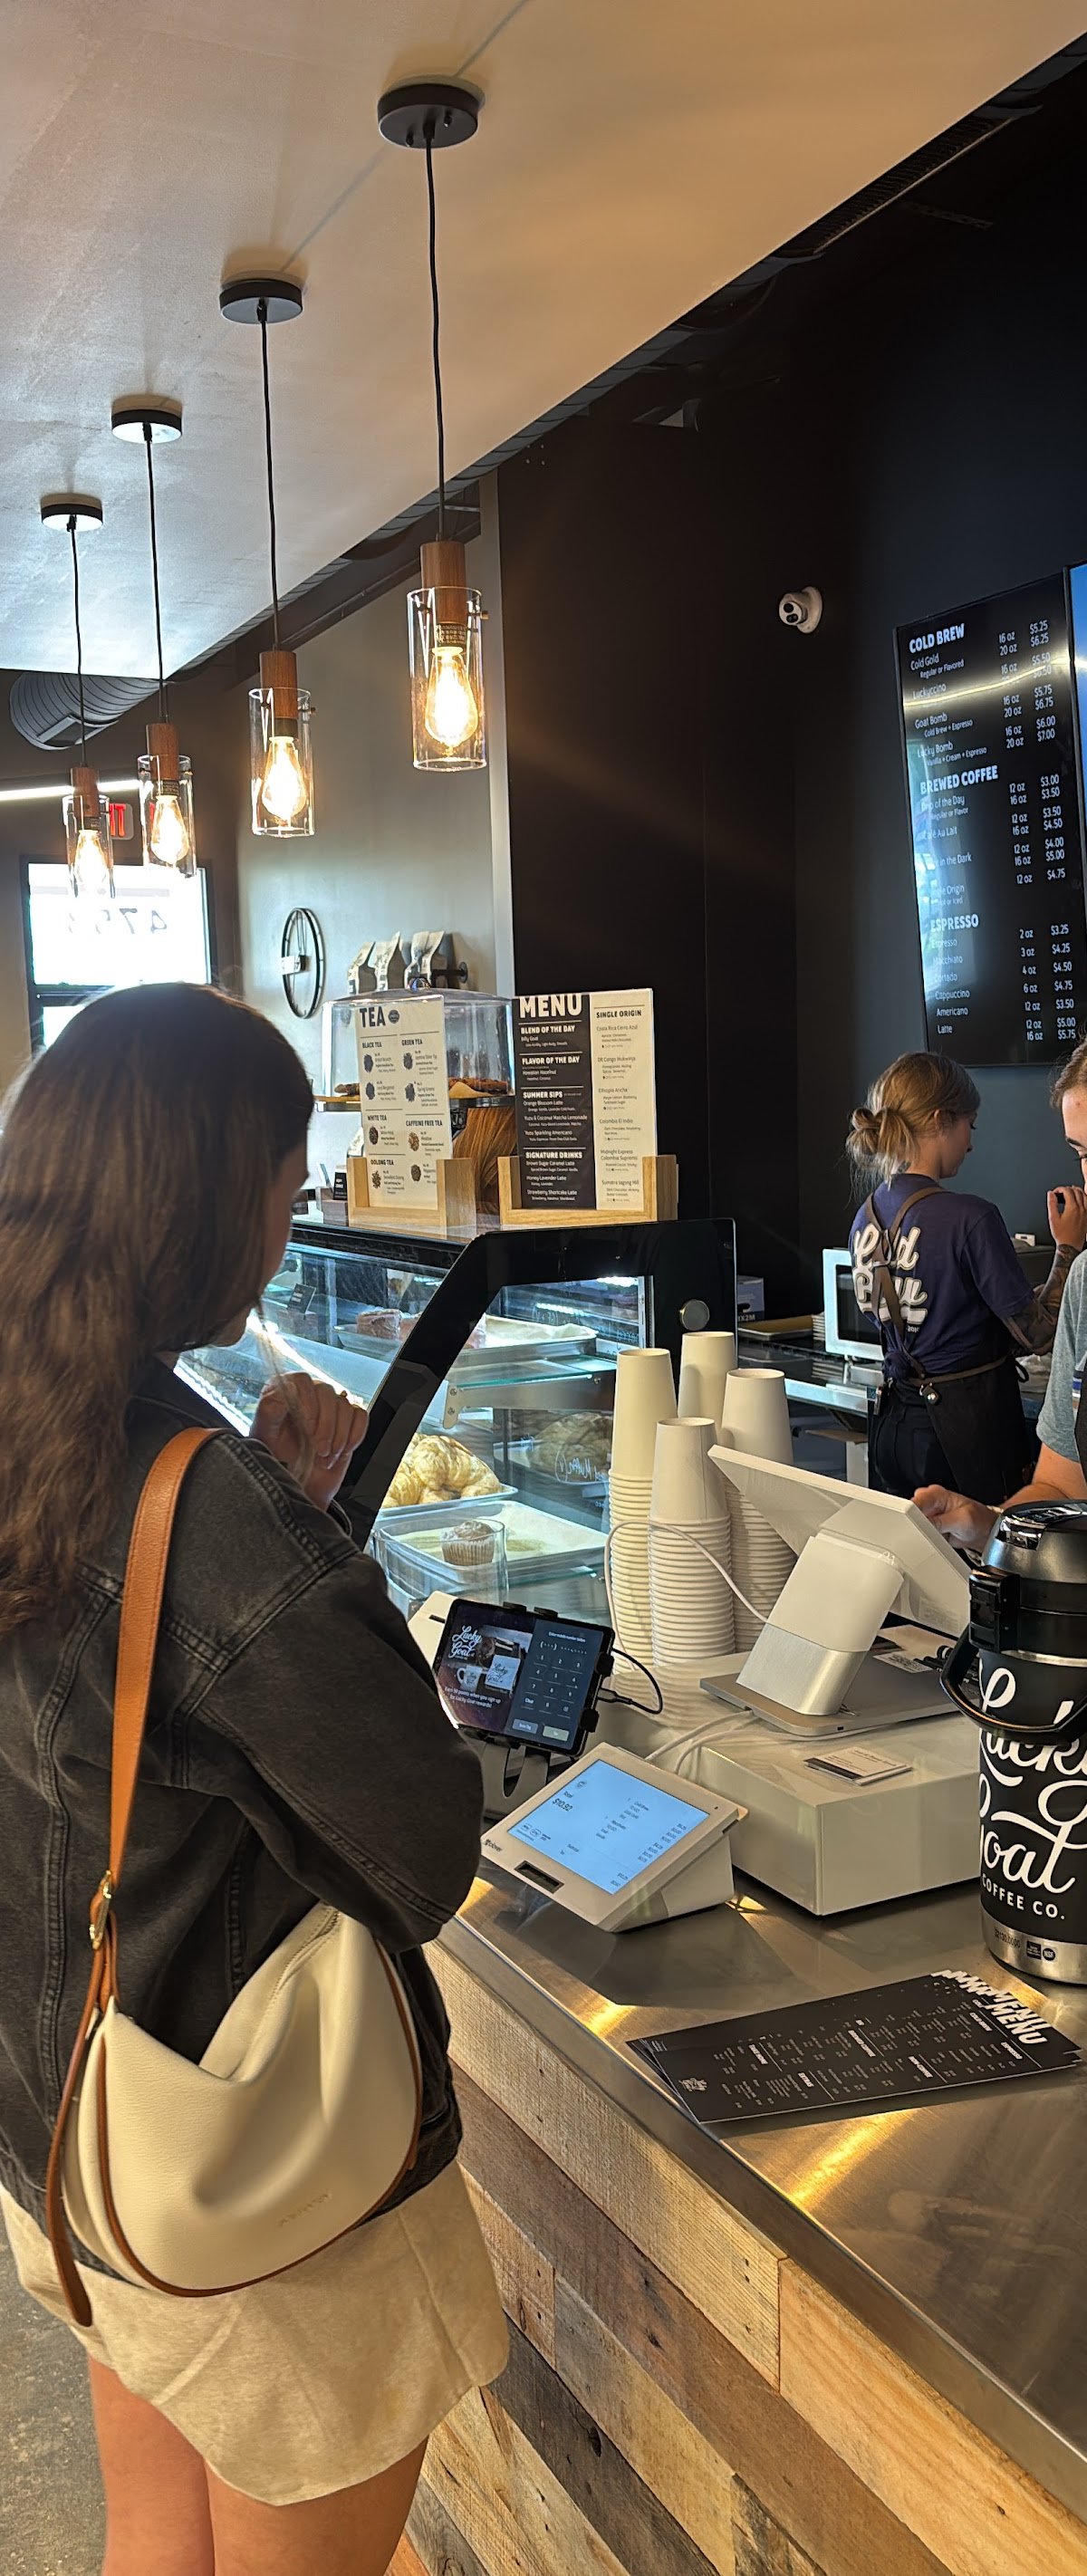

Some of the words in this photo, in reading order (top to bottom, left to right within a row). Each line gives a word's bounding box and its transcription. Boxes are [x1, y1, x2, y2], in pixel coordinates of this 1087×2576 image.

[909, 634, 935, 653] COLD
[936, 623, 965, 645] BREW
[999, 633, 1006, 643] 16
[1007, 631, 1015, 641] oz
[1030, 620, 1048, 634] $5.25
[1000, 645, 1007, 656] 20
[1009, 644, 1017, 653] oz
[1031, 632, 1049, 647] $6.25
[910, 658, 924, 670] Cold
[925, 653, 939, 666] Gold
[920, 668, 937, 678] Regular
[944, 659, 965, 672] Flavored
[1001, 664, 1007, 675] 16
[1009, 663, 1017, 672] oz
[1032, 652, 1051, 665] $5.50
[913, 684, 947, 699] Luckyccino
[1004, 696, 1010, 706] 16
[1012, 695, 1019, 704] oz
[1034, 684, 1053, 697] $5.75
[1005, 706, 1012, 717] 20
[1014, 706, 1022, 716] oz
[1035, 697, 1053, 710] $6.75
[915, 717, 929, 729] Goat
[929, 712, 948, 725] Bomb
[925, 728, 935, 737] Cold
[936, 726, 948, 735] Brew
[952, 720, 973, 731] Espresso
[1005, 726, 1012, 736] 16
[1014, 726, 1022, 735] oz
[1036, 716, 1056, 729] $6.00
[1006, 738, 1015, 748] 20
[1015, 737, 1024, 746] oz
[1037, 728, 1055, 742] $7.00
[936, 741, 953, 753] Bomb
[946, 754, 961, 762] Cream
[966, 747, 987, 758] Espresso
[920, 774, 960, 794] BREWED
[961, 765, 998, 786] COFFEE
[1009, 783, 1015, 793] 12
[1017, 783, 1025, 792] oz
[1041, 774, 1059, 787] $3.00
[935, 798, 941, 808] of
[942, 797, 951, 806] the
[953, 795, 965, 805] Day
[1010, 794, 1017, 804] 16
[1018, 794, 1026, 803] oz
[1042, 786, 1060, 800] $3.50
[954, 808, 968, 816] Flavor
[1012, 813, 1018, 823] 12
[1019, 814, 1027, 822] oz
[1043, 805, 1061, 819] $3.50
[946, 826, 957, 836] Lait
[1013, 825, 1019, 835] 16
[1021, 825, 1029, 834] oz
[1044, 818, 1063, 831] $4.50
[1014, 844, 1020, 854] 12
[1021, 844, 1030, 853] oz
[1045, 837, 1063, 850] $4.00
[947, 856, 957, 865] the
[957, 852, 971, 863] Dark
[1015, 856, 1022, 866] 16
[1023, 856, 1031, 865] oz
[1045, 849, 1064, 862] $5.00
[1016, 874, 1023, 884] 12
[1024, 874, 1033, 883] oz
[1047, 868, 1065, 880] $4.75
[947, 885, 965, 895] Origin
[930, 913, 979, 932] ESPRESSO
[1019, 929, 1024, 938] 2
[1025, 929, 1034, 938] oz
[1051, 924, 1069, 936] $3.25
[1021, 947, 1025, 957] 3
[1026, 948, 1035, 956] oz
[1052, 943, 1070, 955] $4.25
[1023, 966, 1027, 975] 4
[1028, 966, 1036, 975] oz
[1053, 961, 1072, 973] $4.50
[1024, 983, 1028, 993] 6
[1030, 985, 1038, 993] oz
[1054, 980, 1073, 992] $4.75
[935, 990, 970, 1001] Cappuccino
[519, 993, 582, 1018] MENU
[937, 1007, 968, 1016] Americano
[1024, 1002, 1031, 1011] 12
[1033, 1003, 1041, 1011] oz
[1056, 999, 1073, 1009] $3.50
[360, 1005, 386, 1028] TEA
[1026, 1020, 1032, 1029] 12
[1034, 1021, 1042, 1029] oz
[1057, 1017, 1076, 1028] $5.00
[521, 1026, 540, 1034] BLEND
[938, 1024, 953, 1034] Latte
[1027, 1032, 1033, 1041] 16
[1035, 1033, 1043, 1041] oz
[1058, 1029, 1076, 1040] $5.75
[522, 1057, 544, 1065] FLAVOR
[452, 1625, 482, 1646] Lucky
[982, 1873, 1024, 1910] COFFEE
[1033, 1900, 1065, 1920] CO.
[984, 2004, 1048, 2044] MENU
